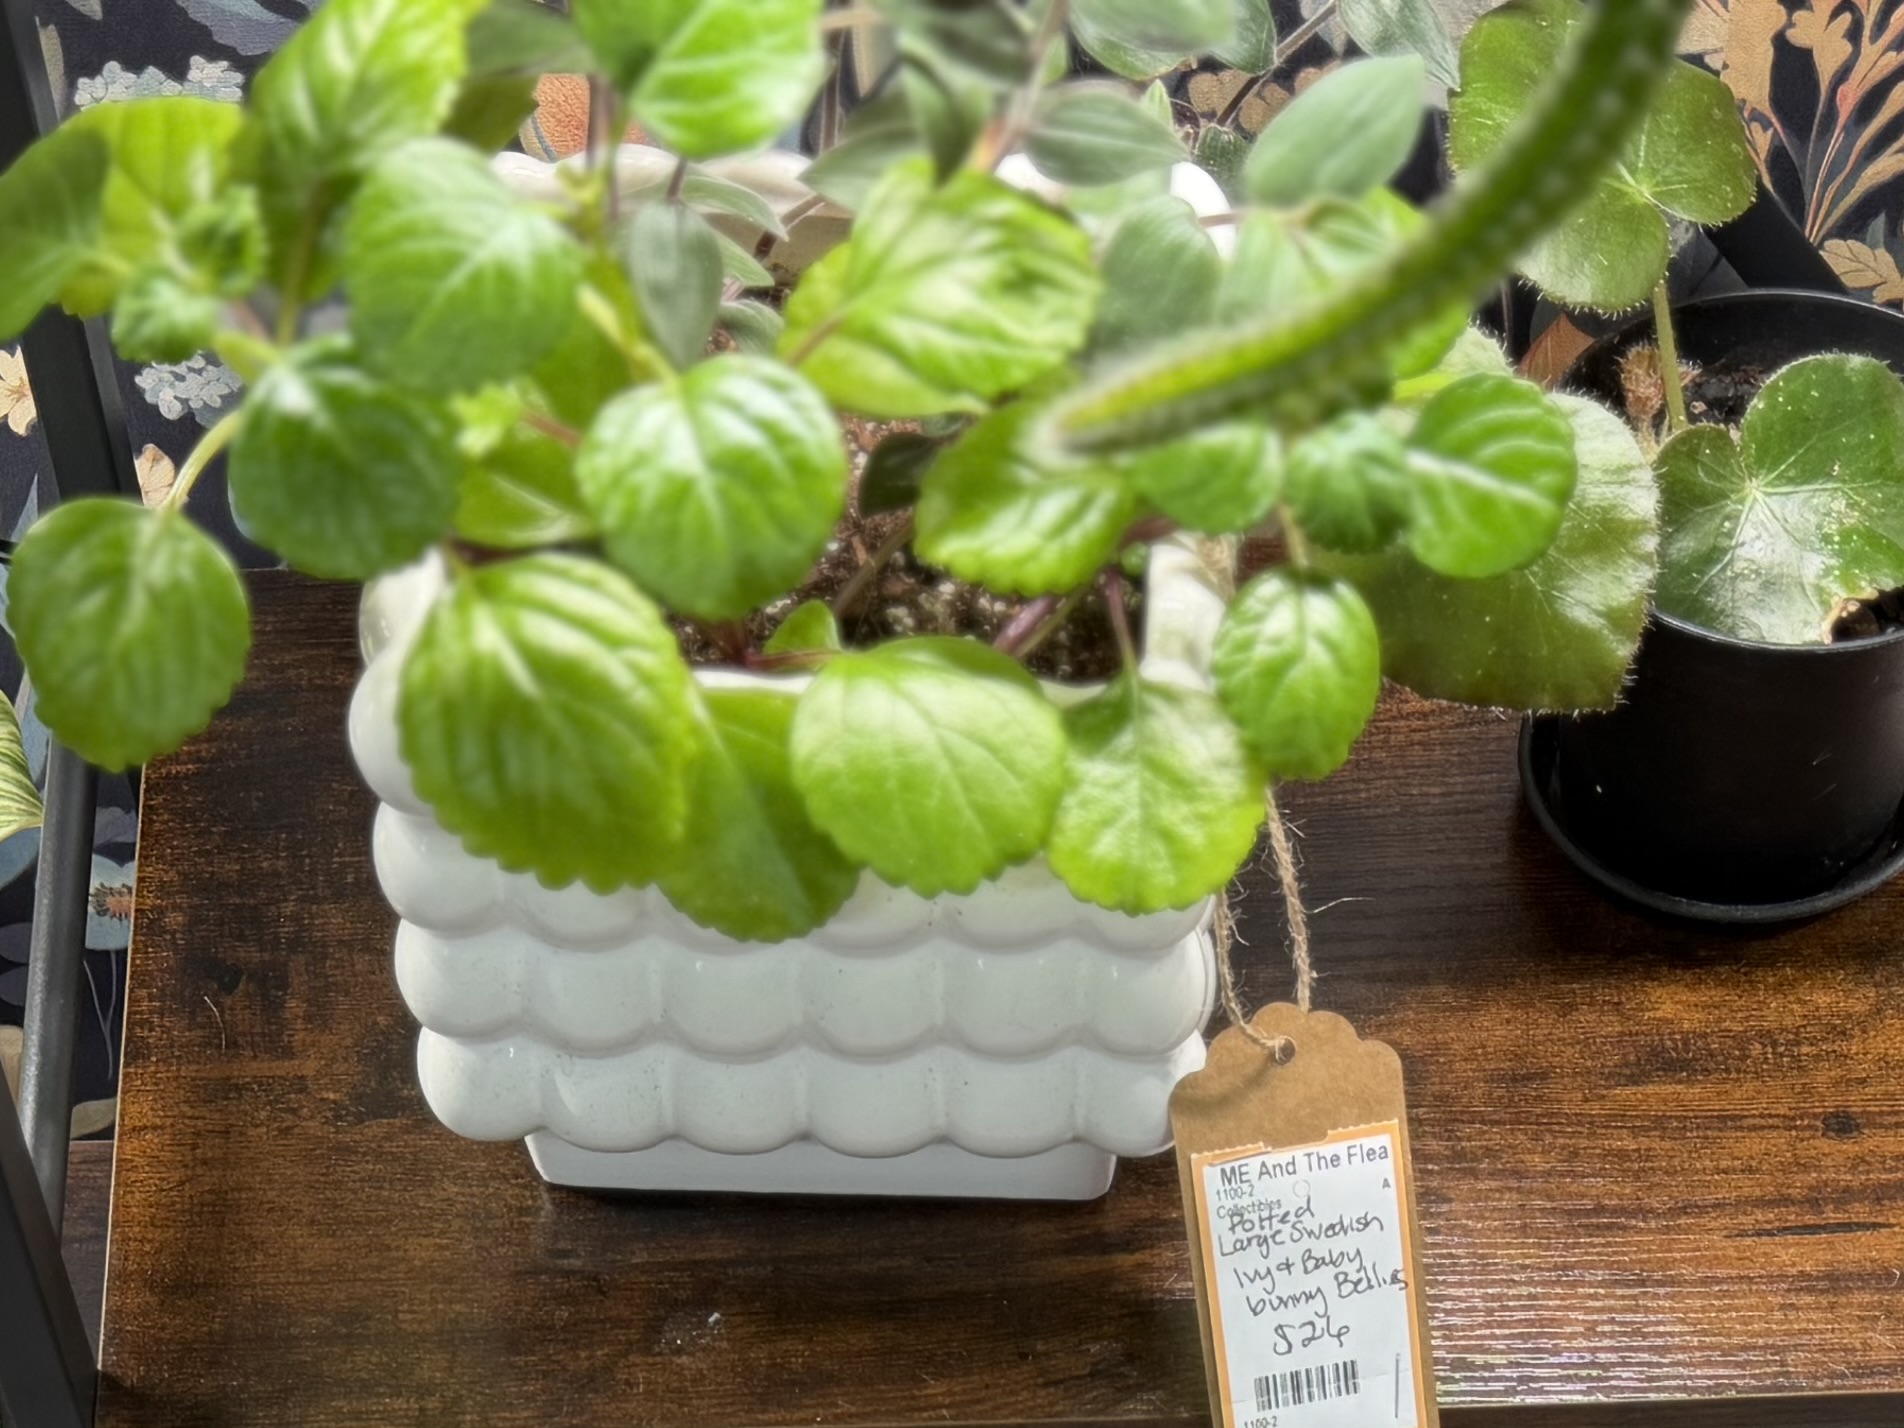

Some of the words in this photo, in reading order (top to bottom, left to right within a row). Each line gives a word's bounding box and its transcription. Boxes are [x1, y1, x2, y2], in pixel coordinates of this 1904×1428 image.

[1220, 1163, 1252, 1187] ME
[1257, 1156, 1297, 1181] And
[1304, 1148, 1341, 1173] The
[1347, 1141, 1389, 1166] Flea
[1381, 1177, 1391, 1190] A
[1216, 1184, 1255, 1201] 1100-2
[1216, 1198, 1282, 1220] Collectibles
[1227, 1195, 1315, 1235] Potted
[1218, 1229, 1286, 1260] Large
[1289, 1213, 1384, 1244] Swedish
[1233, 1261, 1276, 1296] Ivy
[1301, 1247, 1363, 1275] Baby
